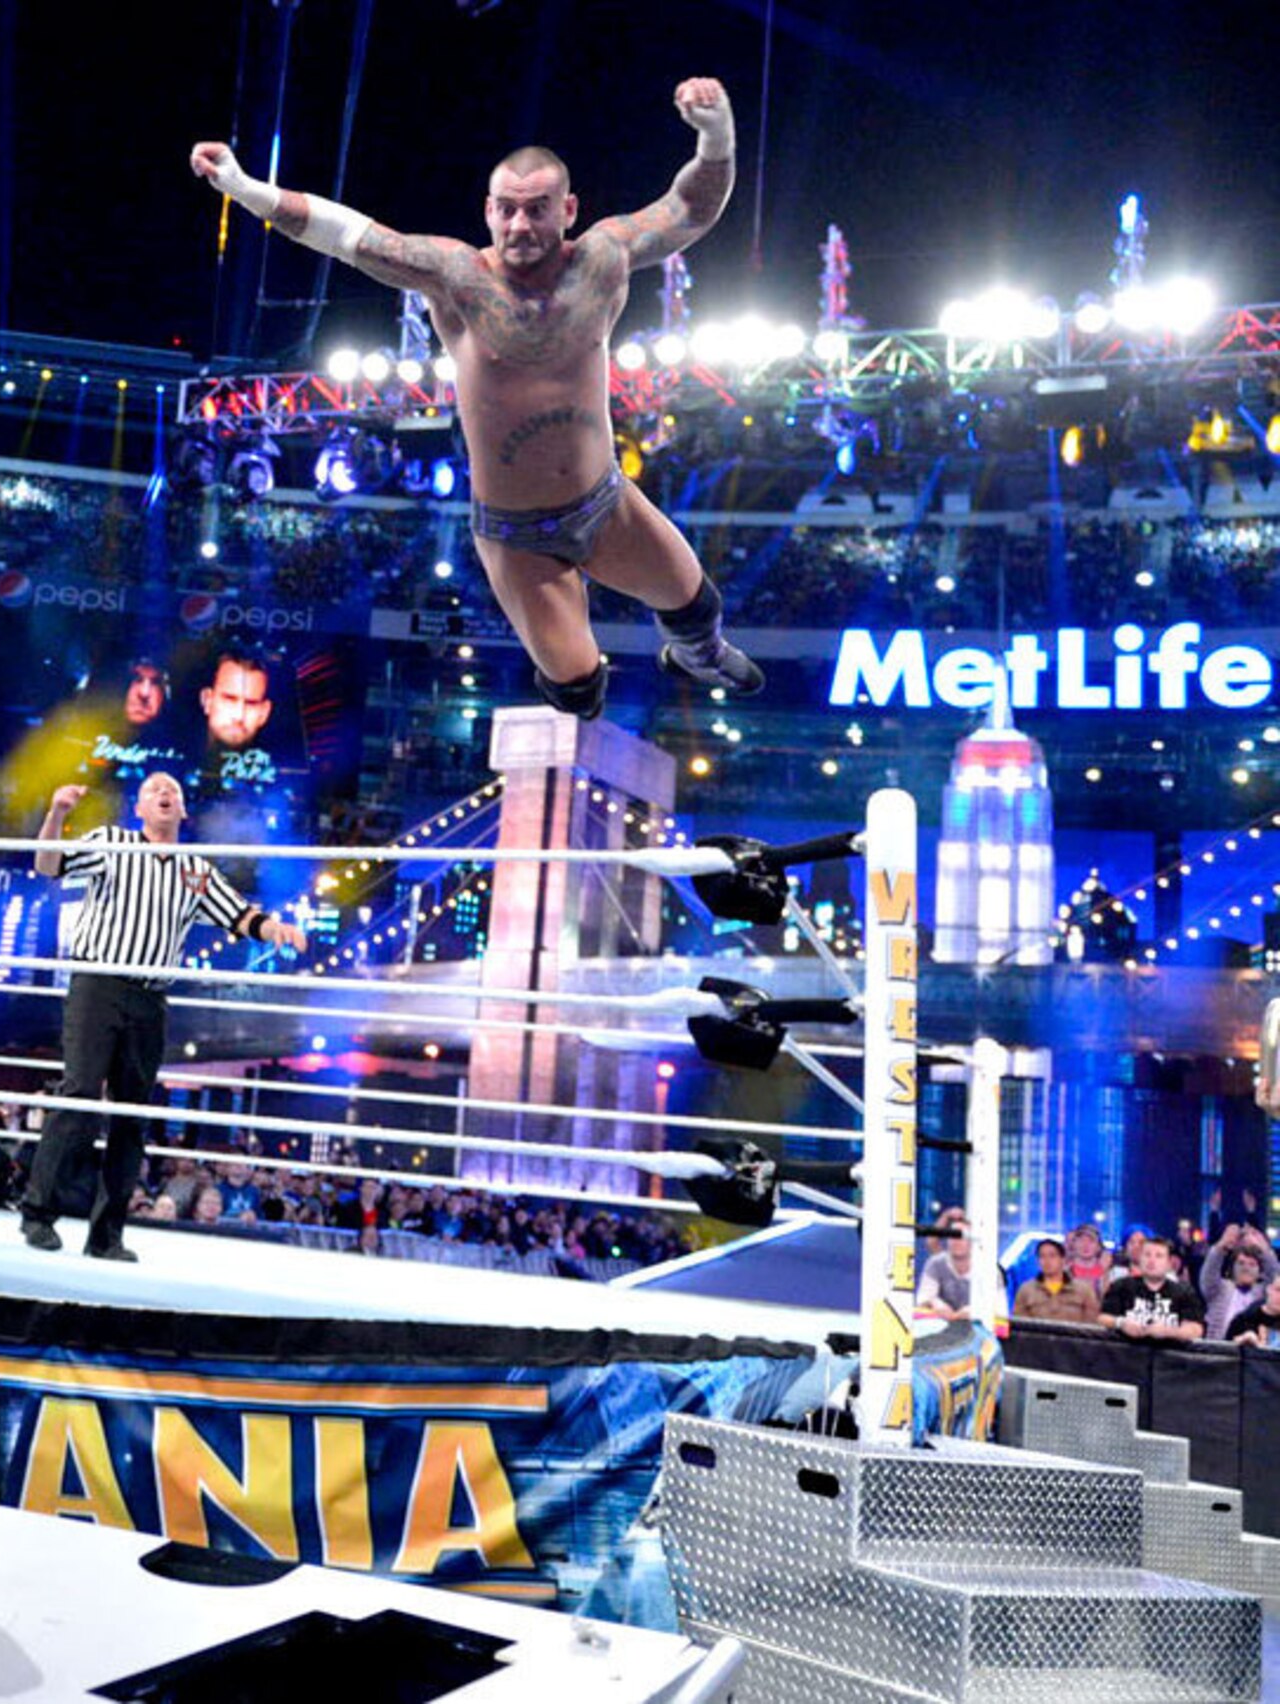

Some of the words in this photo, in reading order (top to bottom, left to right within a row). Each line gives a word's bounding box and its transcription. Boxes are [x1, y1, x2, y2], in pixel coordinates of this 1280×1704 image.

[33, 582, 126, 613] pepsi
[220, 604, 314, 631] pepsi
[829, 621, 1273, 709] MetLife
